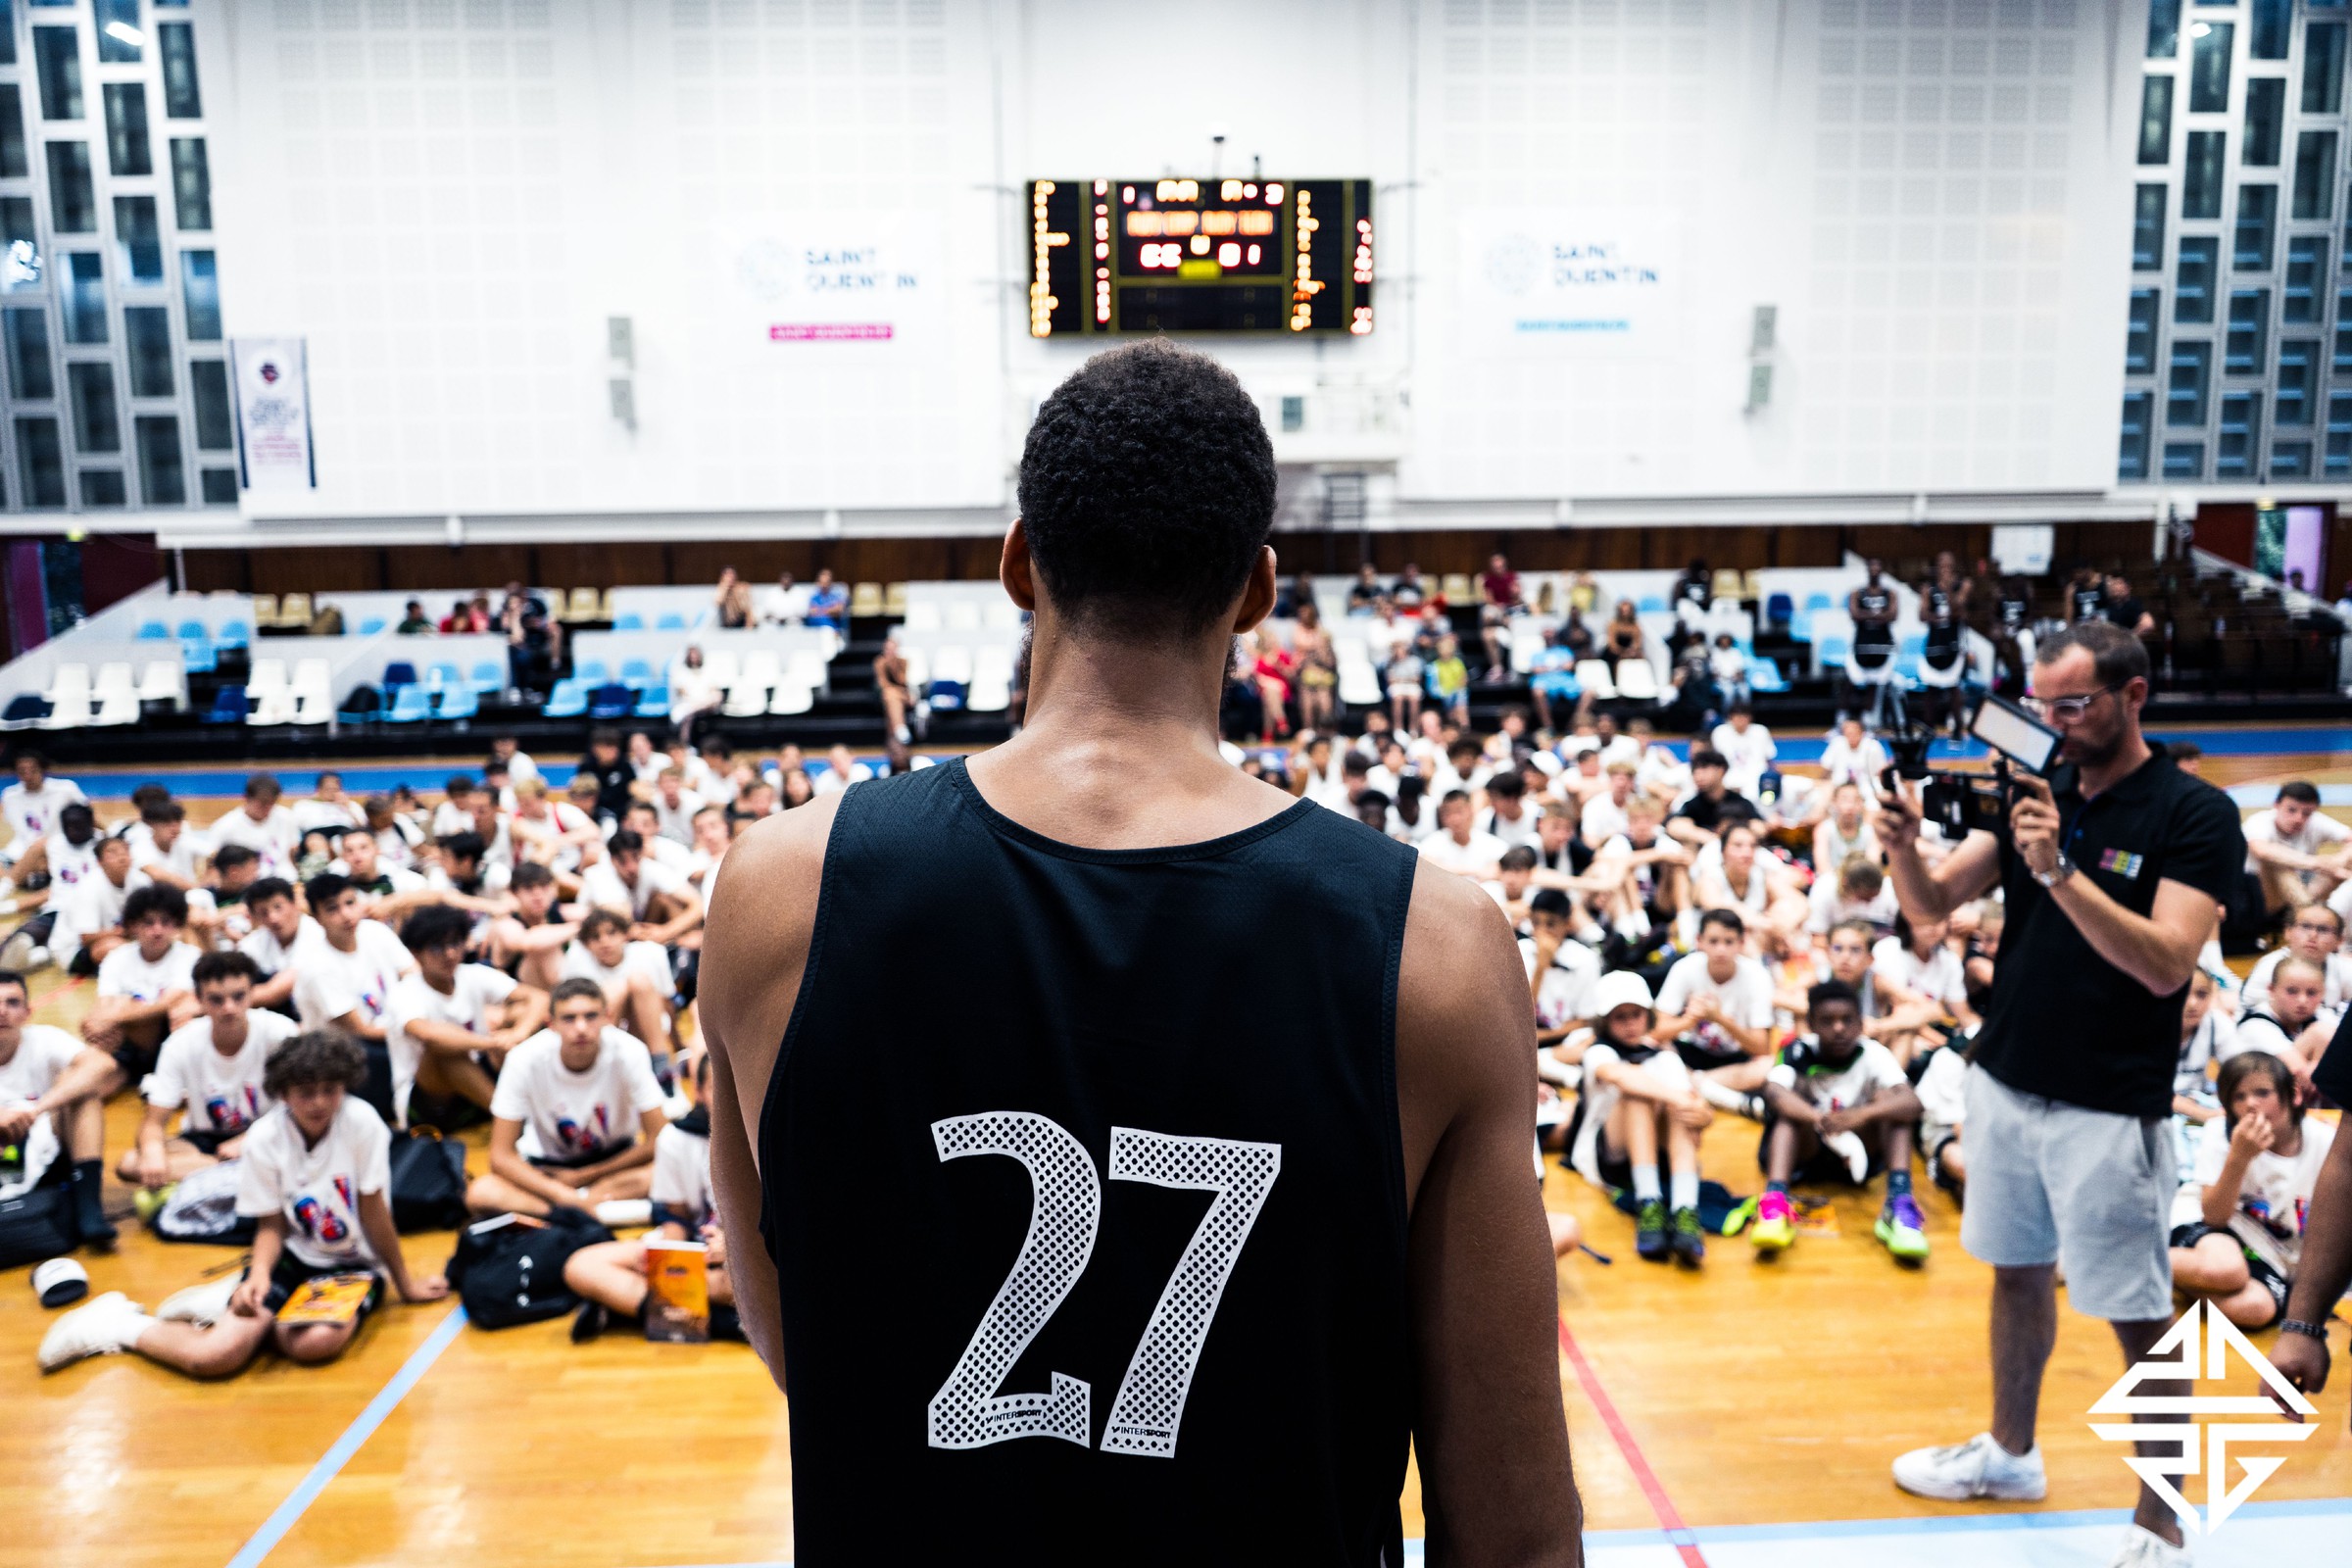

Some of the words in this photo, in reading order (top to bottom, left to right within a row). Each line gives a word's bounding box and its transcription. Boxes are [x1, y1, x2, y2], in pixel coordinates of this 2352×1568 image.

[928, 1110, 1282, 1459] 27
[994, 1409, 1042, 1422] INTERSPORT
[1120, 1427, 1171, 1439] INTERSPORT
